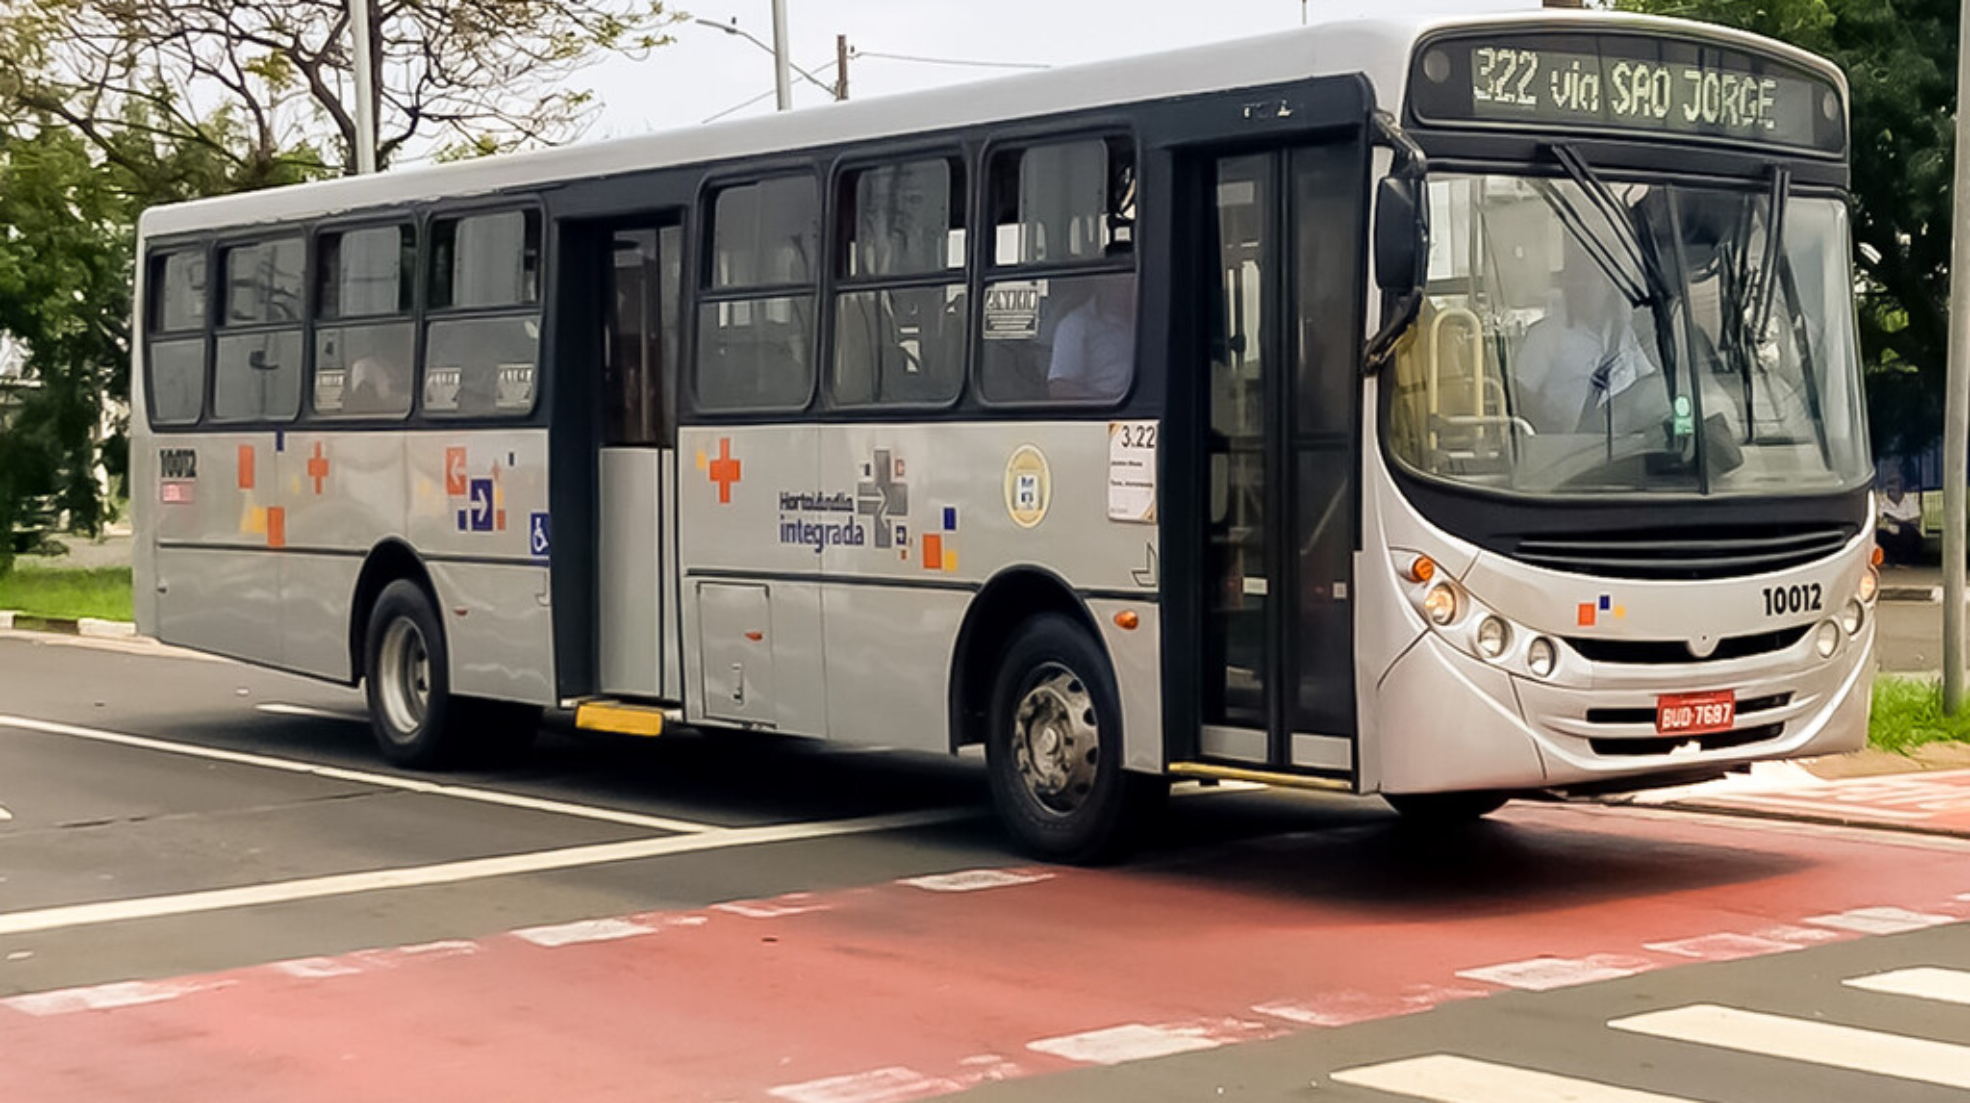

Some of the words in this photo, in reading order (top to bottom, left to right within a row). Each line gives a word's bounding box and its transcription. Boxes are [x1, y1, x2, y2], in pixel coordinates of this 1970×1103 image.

[1473, 47, 1538, 105] 322
[1551, 61, 1599, 111] via
[1683, 70, 1777, 129] JORGE
[1121, 424, 1156, 449] 3.22
[780, 514, 865, 553] integrada
[1763, 583, 1822, 616] 10012
